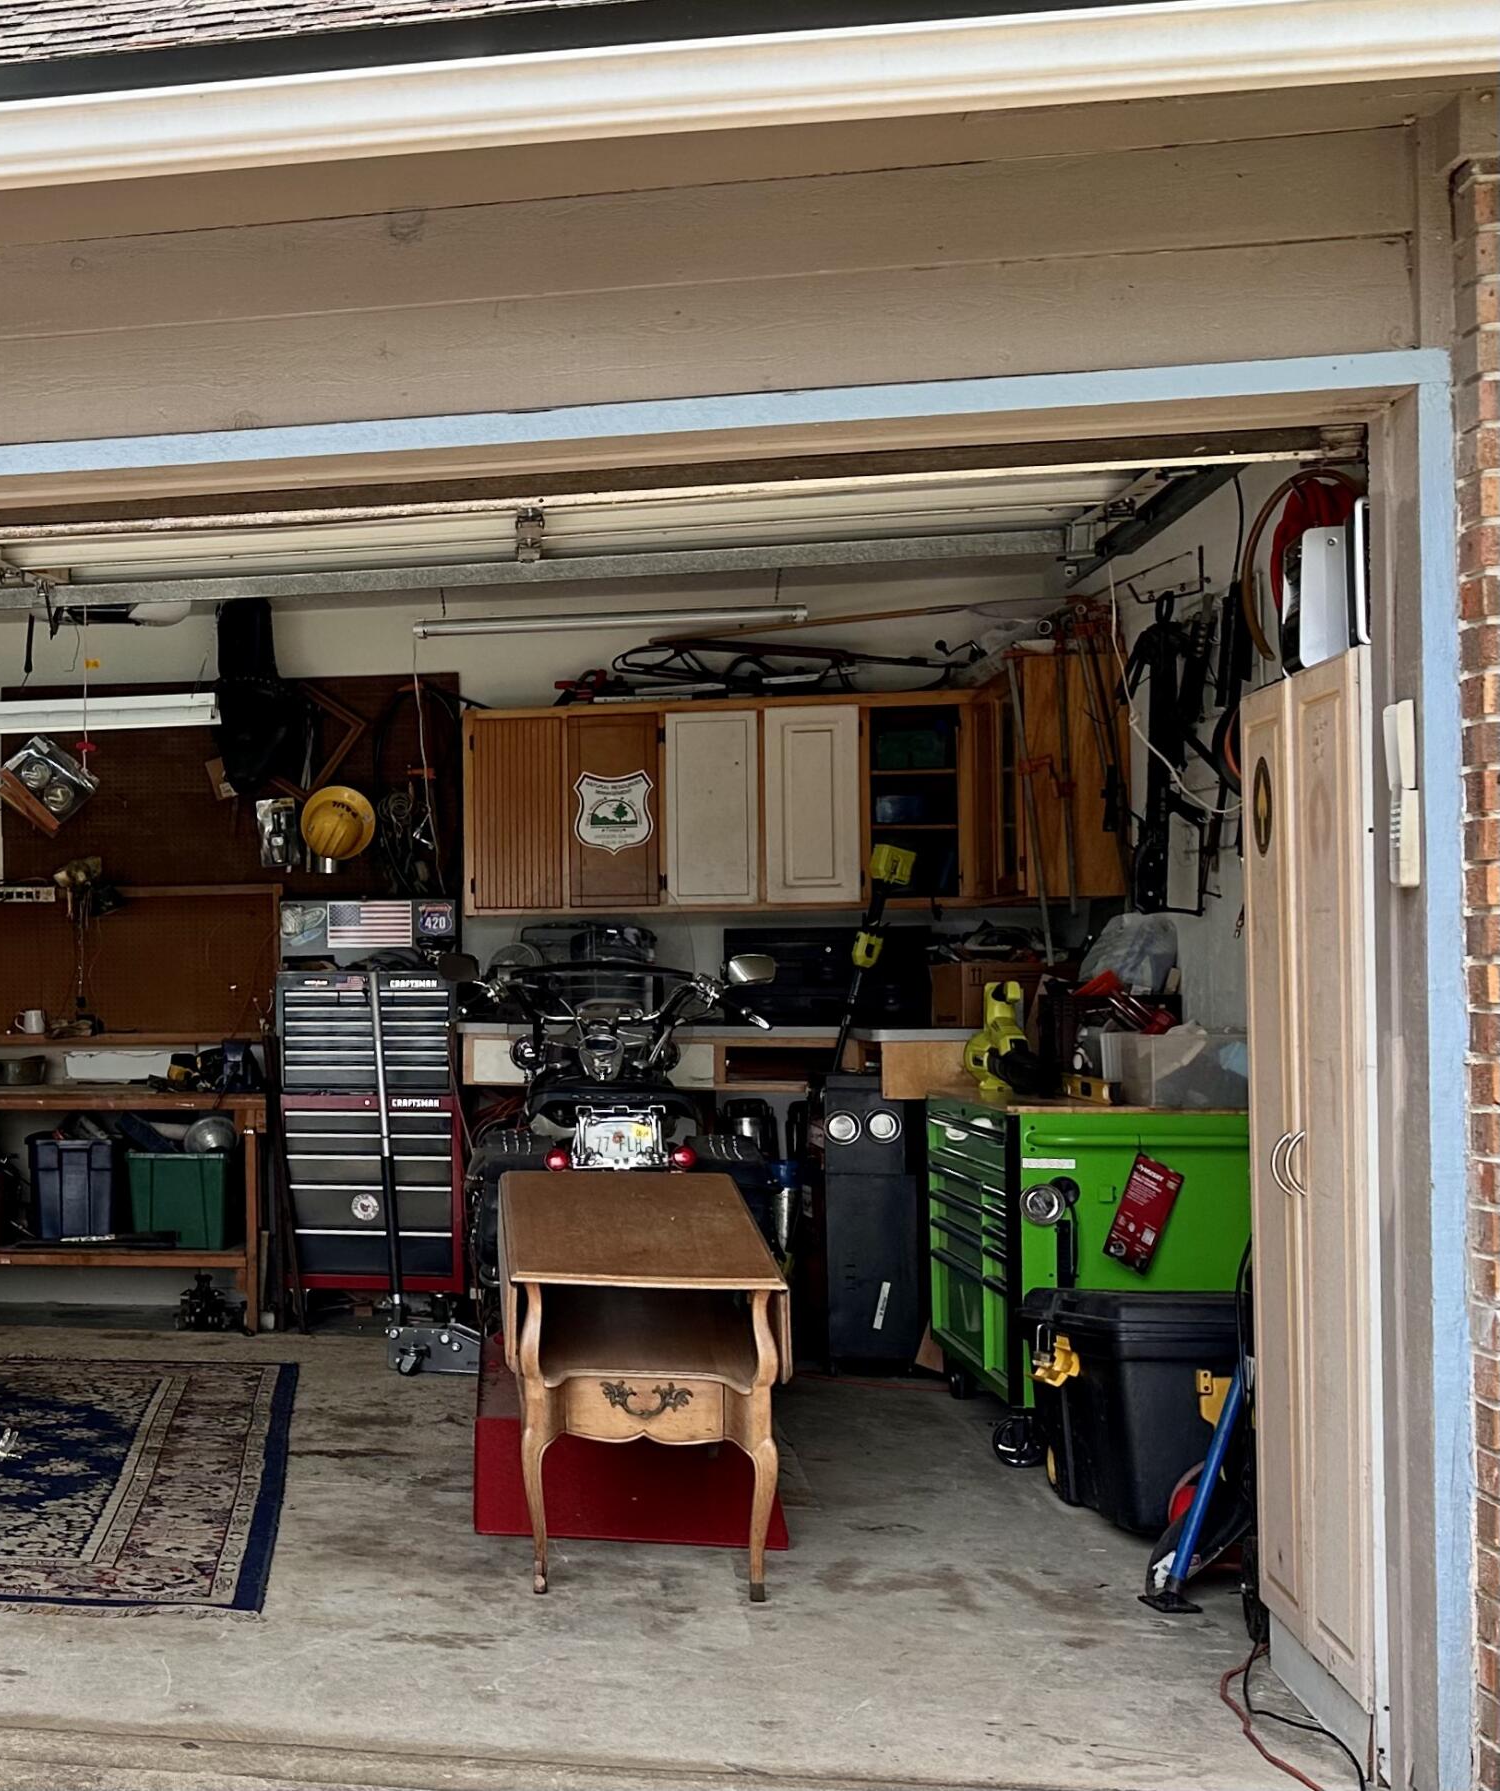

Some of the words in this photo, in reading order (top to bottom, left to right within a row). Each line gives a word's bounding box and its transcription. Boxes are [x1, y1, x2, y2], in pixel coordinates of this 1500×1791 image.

[424, 916, 446, 930] 420
[389, 979, 438, 988] CRAFTSMAN
[391, 1098, 440, 1108] CRAFTSMAN
